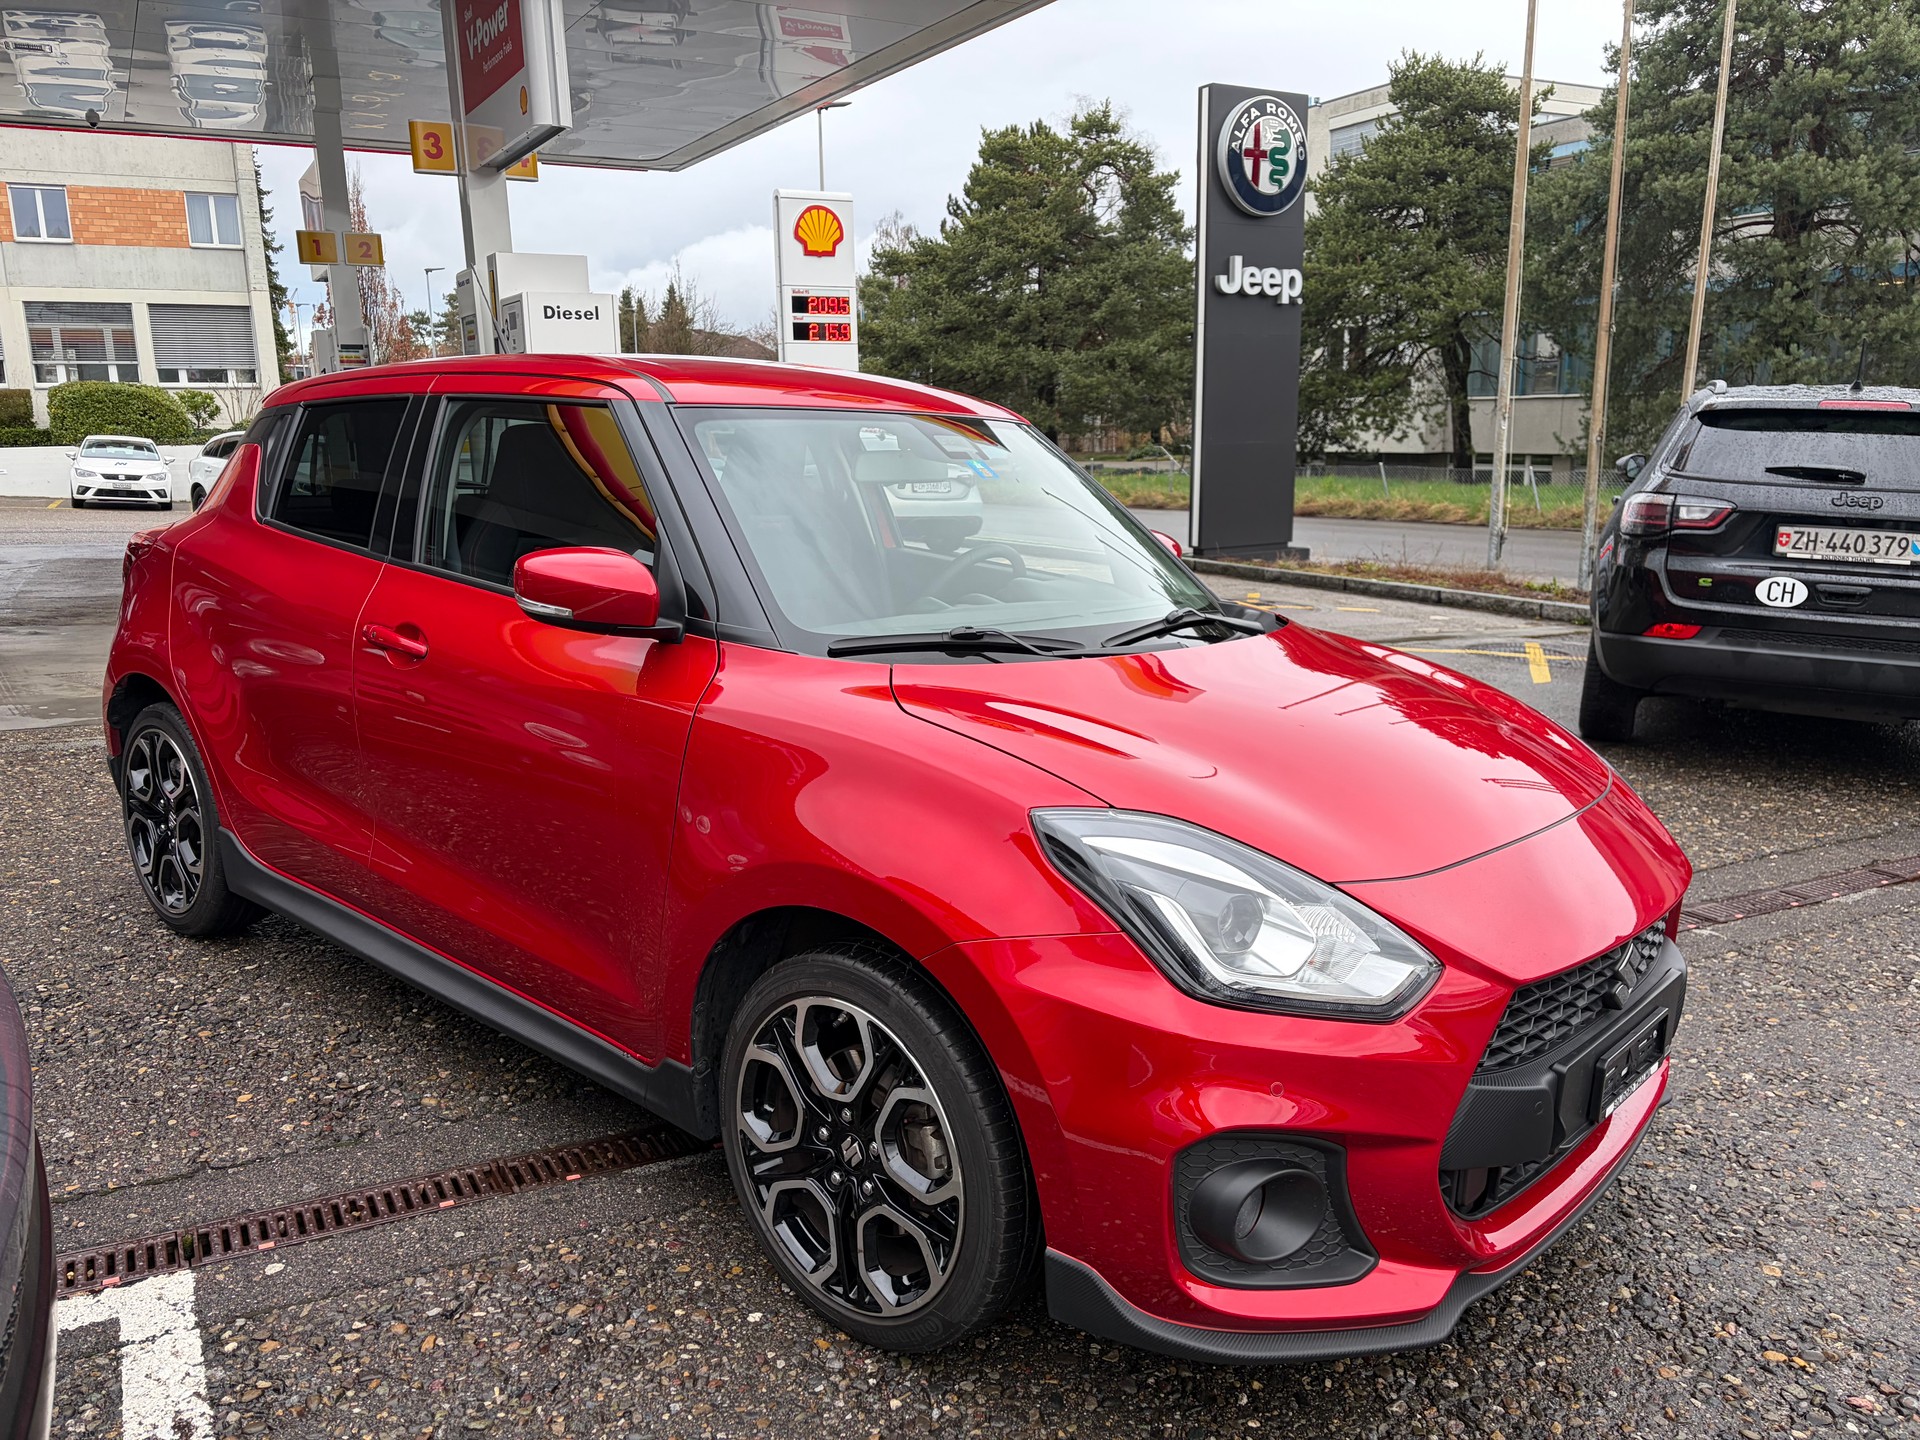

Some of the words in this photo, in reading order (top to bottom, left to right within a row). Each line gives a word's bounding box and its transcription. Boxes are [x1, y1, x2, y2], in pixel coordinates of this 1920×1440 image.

[466, 1, 509, 60] V-Power
[1231, 107, 1261, 153] ALFA
[1266, 103, 1306, 161] ROMEO
[423, 131, 444, 160] 3
[312, 239, 322, 256] 1
[358, 241, 373, 258] 2
[543, 304, 600, 321] Diesel
[1831, 492, 1884, 511] Jeep
[1766, 580, 1796, 603] CH
